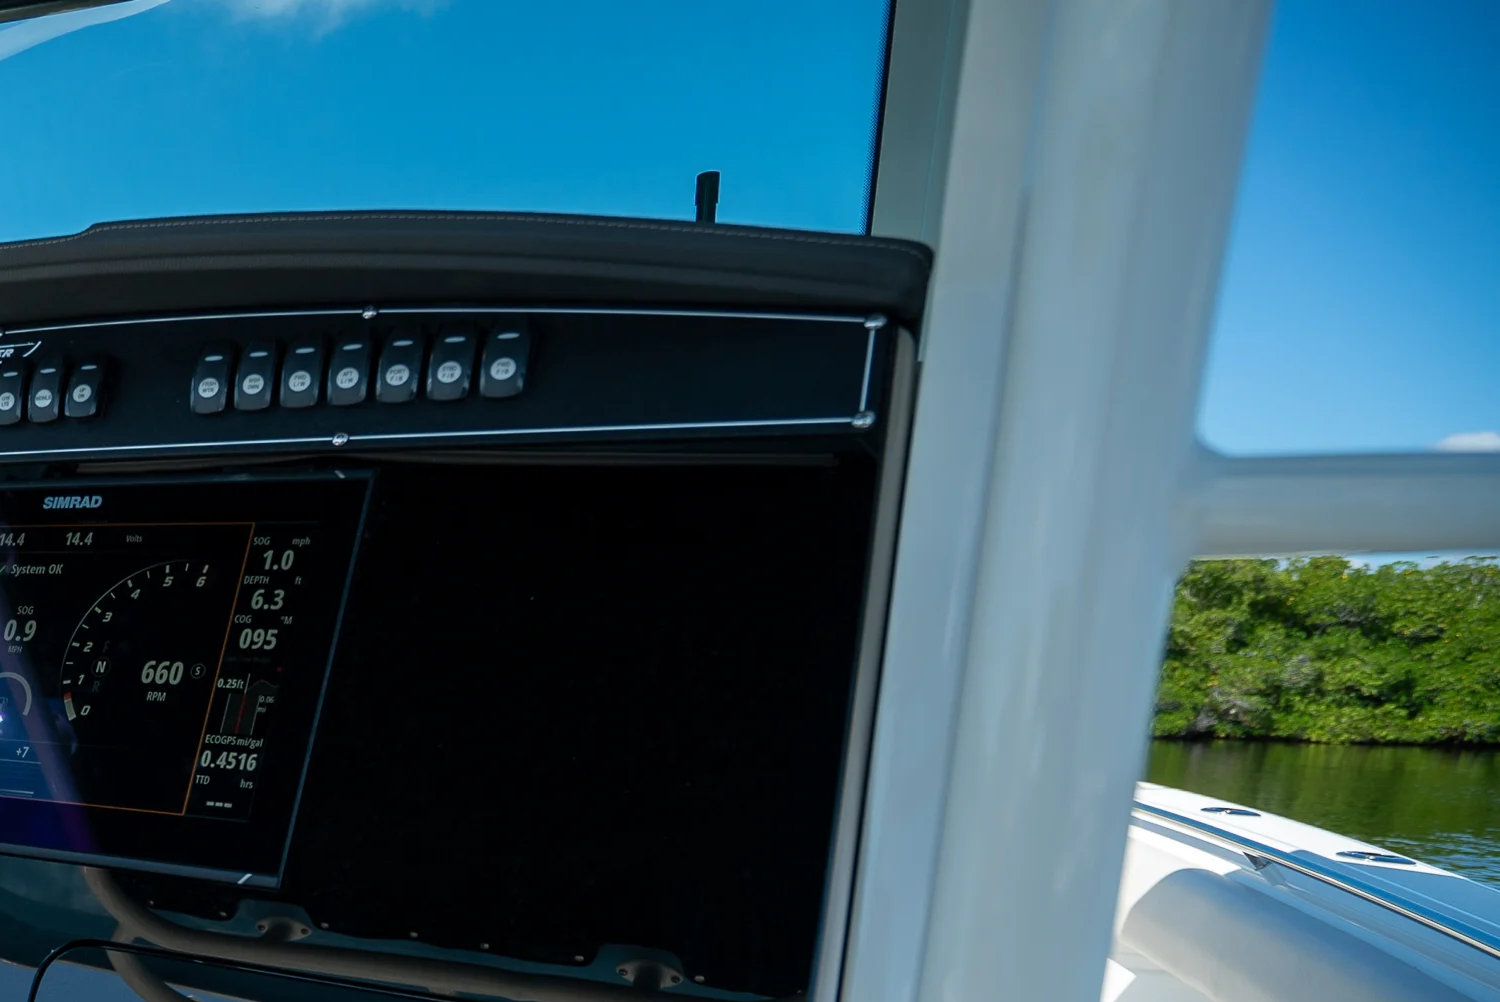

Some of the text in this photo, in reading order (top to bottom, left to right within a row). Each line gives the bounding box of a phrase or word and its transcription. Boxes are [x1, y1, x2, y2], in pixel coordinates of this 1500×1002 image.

[42, 496, 103, 510] SIMRAD
[0, 532, 143, 547] 14.4 14.4 Volts
[253, 536, 311, 547] SOG mph
[263, 549, 295, 571] 1.0
[10, 564, 64, 577] System OK
[162, 576, 174, 587] 5
[195, 576, 207, 587] 6
[243, 575, 303, 585] DEPTH ft
[130, 589, 141, 600] 4
[250, 588, 285, 610] 6.3
[16, 605, 35, 615] SOG
[101, 612, 113, 623] 3
[234, 614, 253, 624] COG
[3, 619, 37, 642] 0.9
[238, 628, 279, 651] 095
[82, 641, 94, 653] 2
[95, 661, 107, 674] N
[141, 660, 184, 686] 660
[194, 666, 202, 676] S
[77, 674, 86, 686] 1
[217, 678, 244, 690] 0.25ft
[146, 691, 167, 702] RPM
[80, 705, 91, 716] 0
[204, 734, 264, 749] ECOGPS mi/gal
[16, 746, 30, 758] +7
[200, 750, 258, 771] 0.4516
[195, 774, 254, 789] TTD hrs
